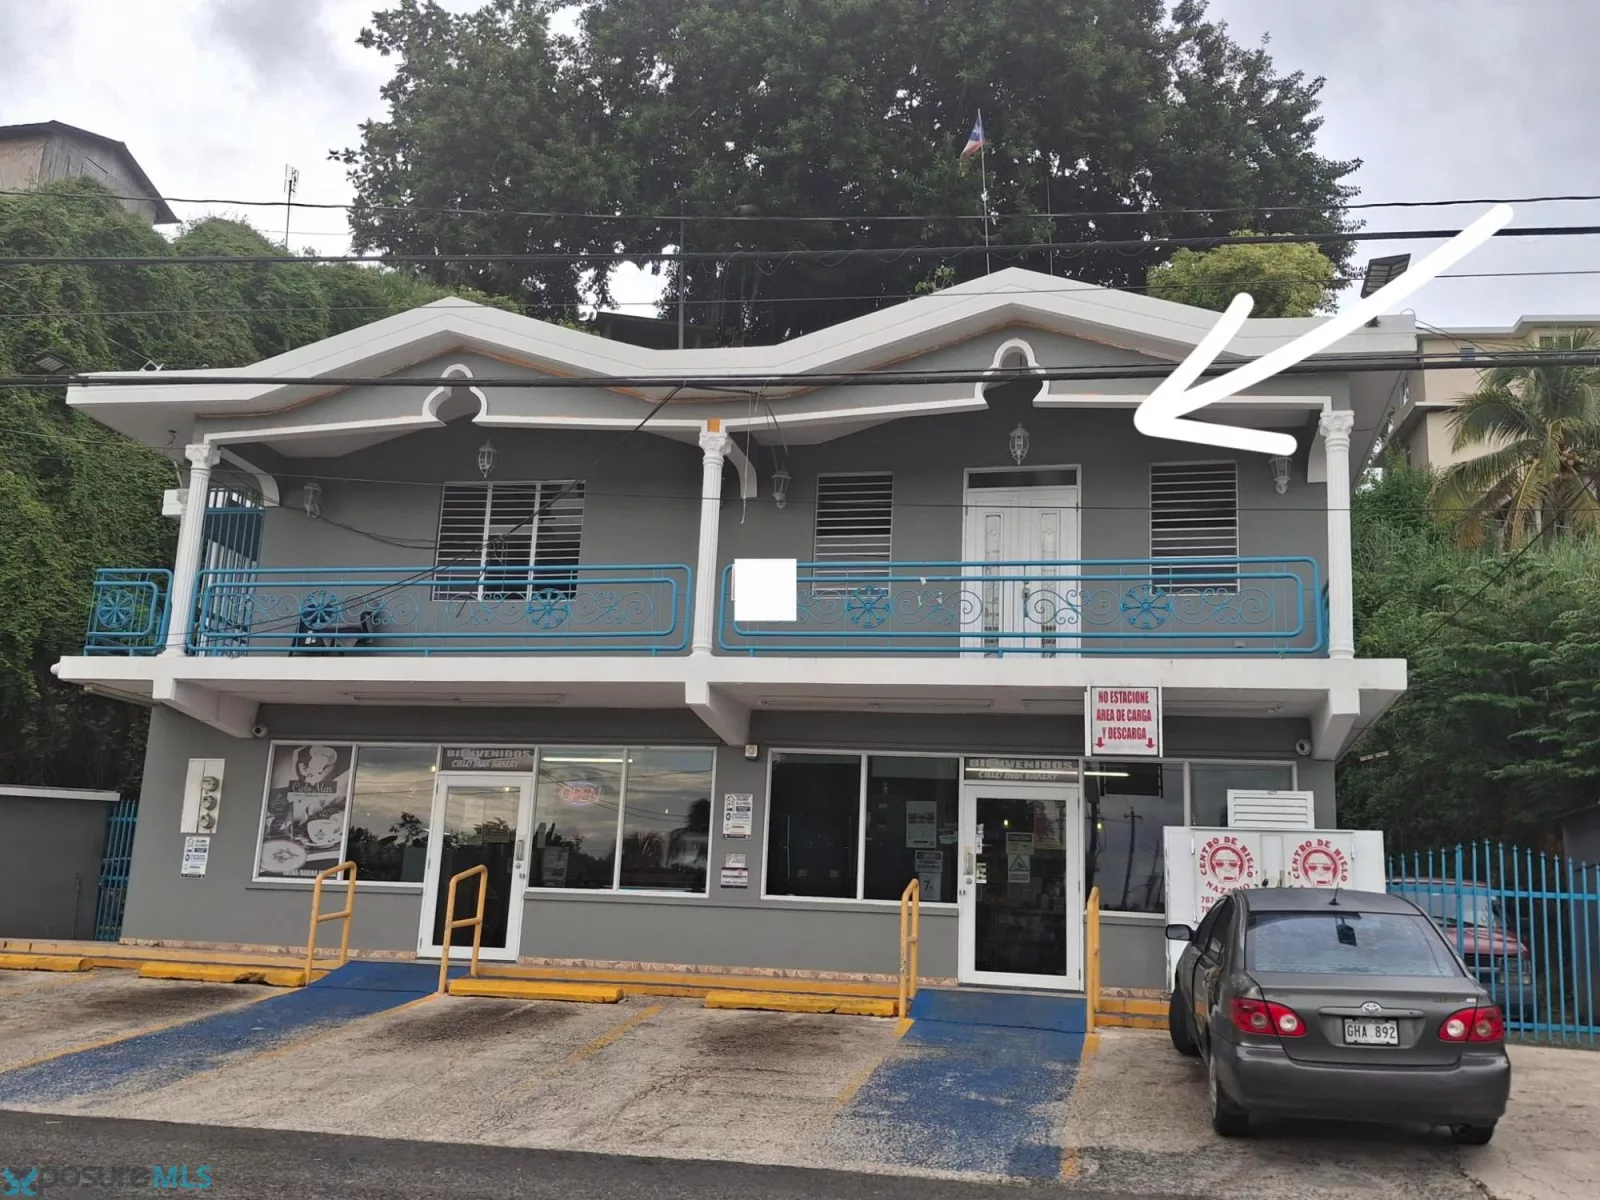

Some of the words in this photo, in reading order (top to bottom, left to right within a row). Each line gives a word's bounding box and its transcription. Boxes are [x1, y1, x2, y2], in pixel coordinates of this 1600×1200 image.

[1098, 690, 1108, 704] NO
[1110, 690, 1149, 704] ESTACIONE
[1096, 708, 1115, 722] AREA
[1116, 708, 1125, 722] DE
[1127, 708, 1152, 722] CARGA
[1102, 726, 1107, 740] Y
[1108, 727, 1147, 740] DESCARGA
[561, 786, 602, 802] OPEN
[1199, 837, 1220, 876] CENTRO
[1223, 836, 1238, 845] DE
[1240, 845, 1254, 878] HIELO
[1291, 840, 1312, 879] CENTRO
[1317, 838, 1331, 848] DE
[1334, 848, 1348, 882] HIELO
[1206, 880, 1250, 893] NAZRIO
[1347, 1025, 1367, 1038] GHA
[1375, 1025, 1396, 1039] 892
